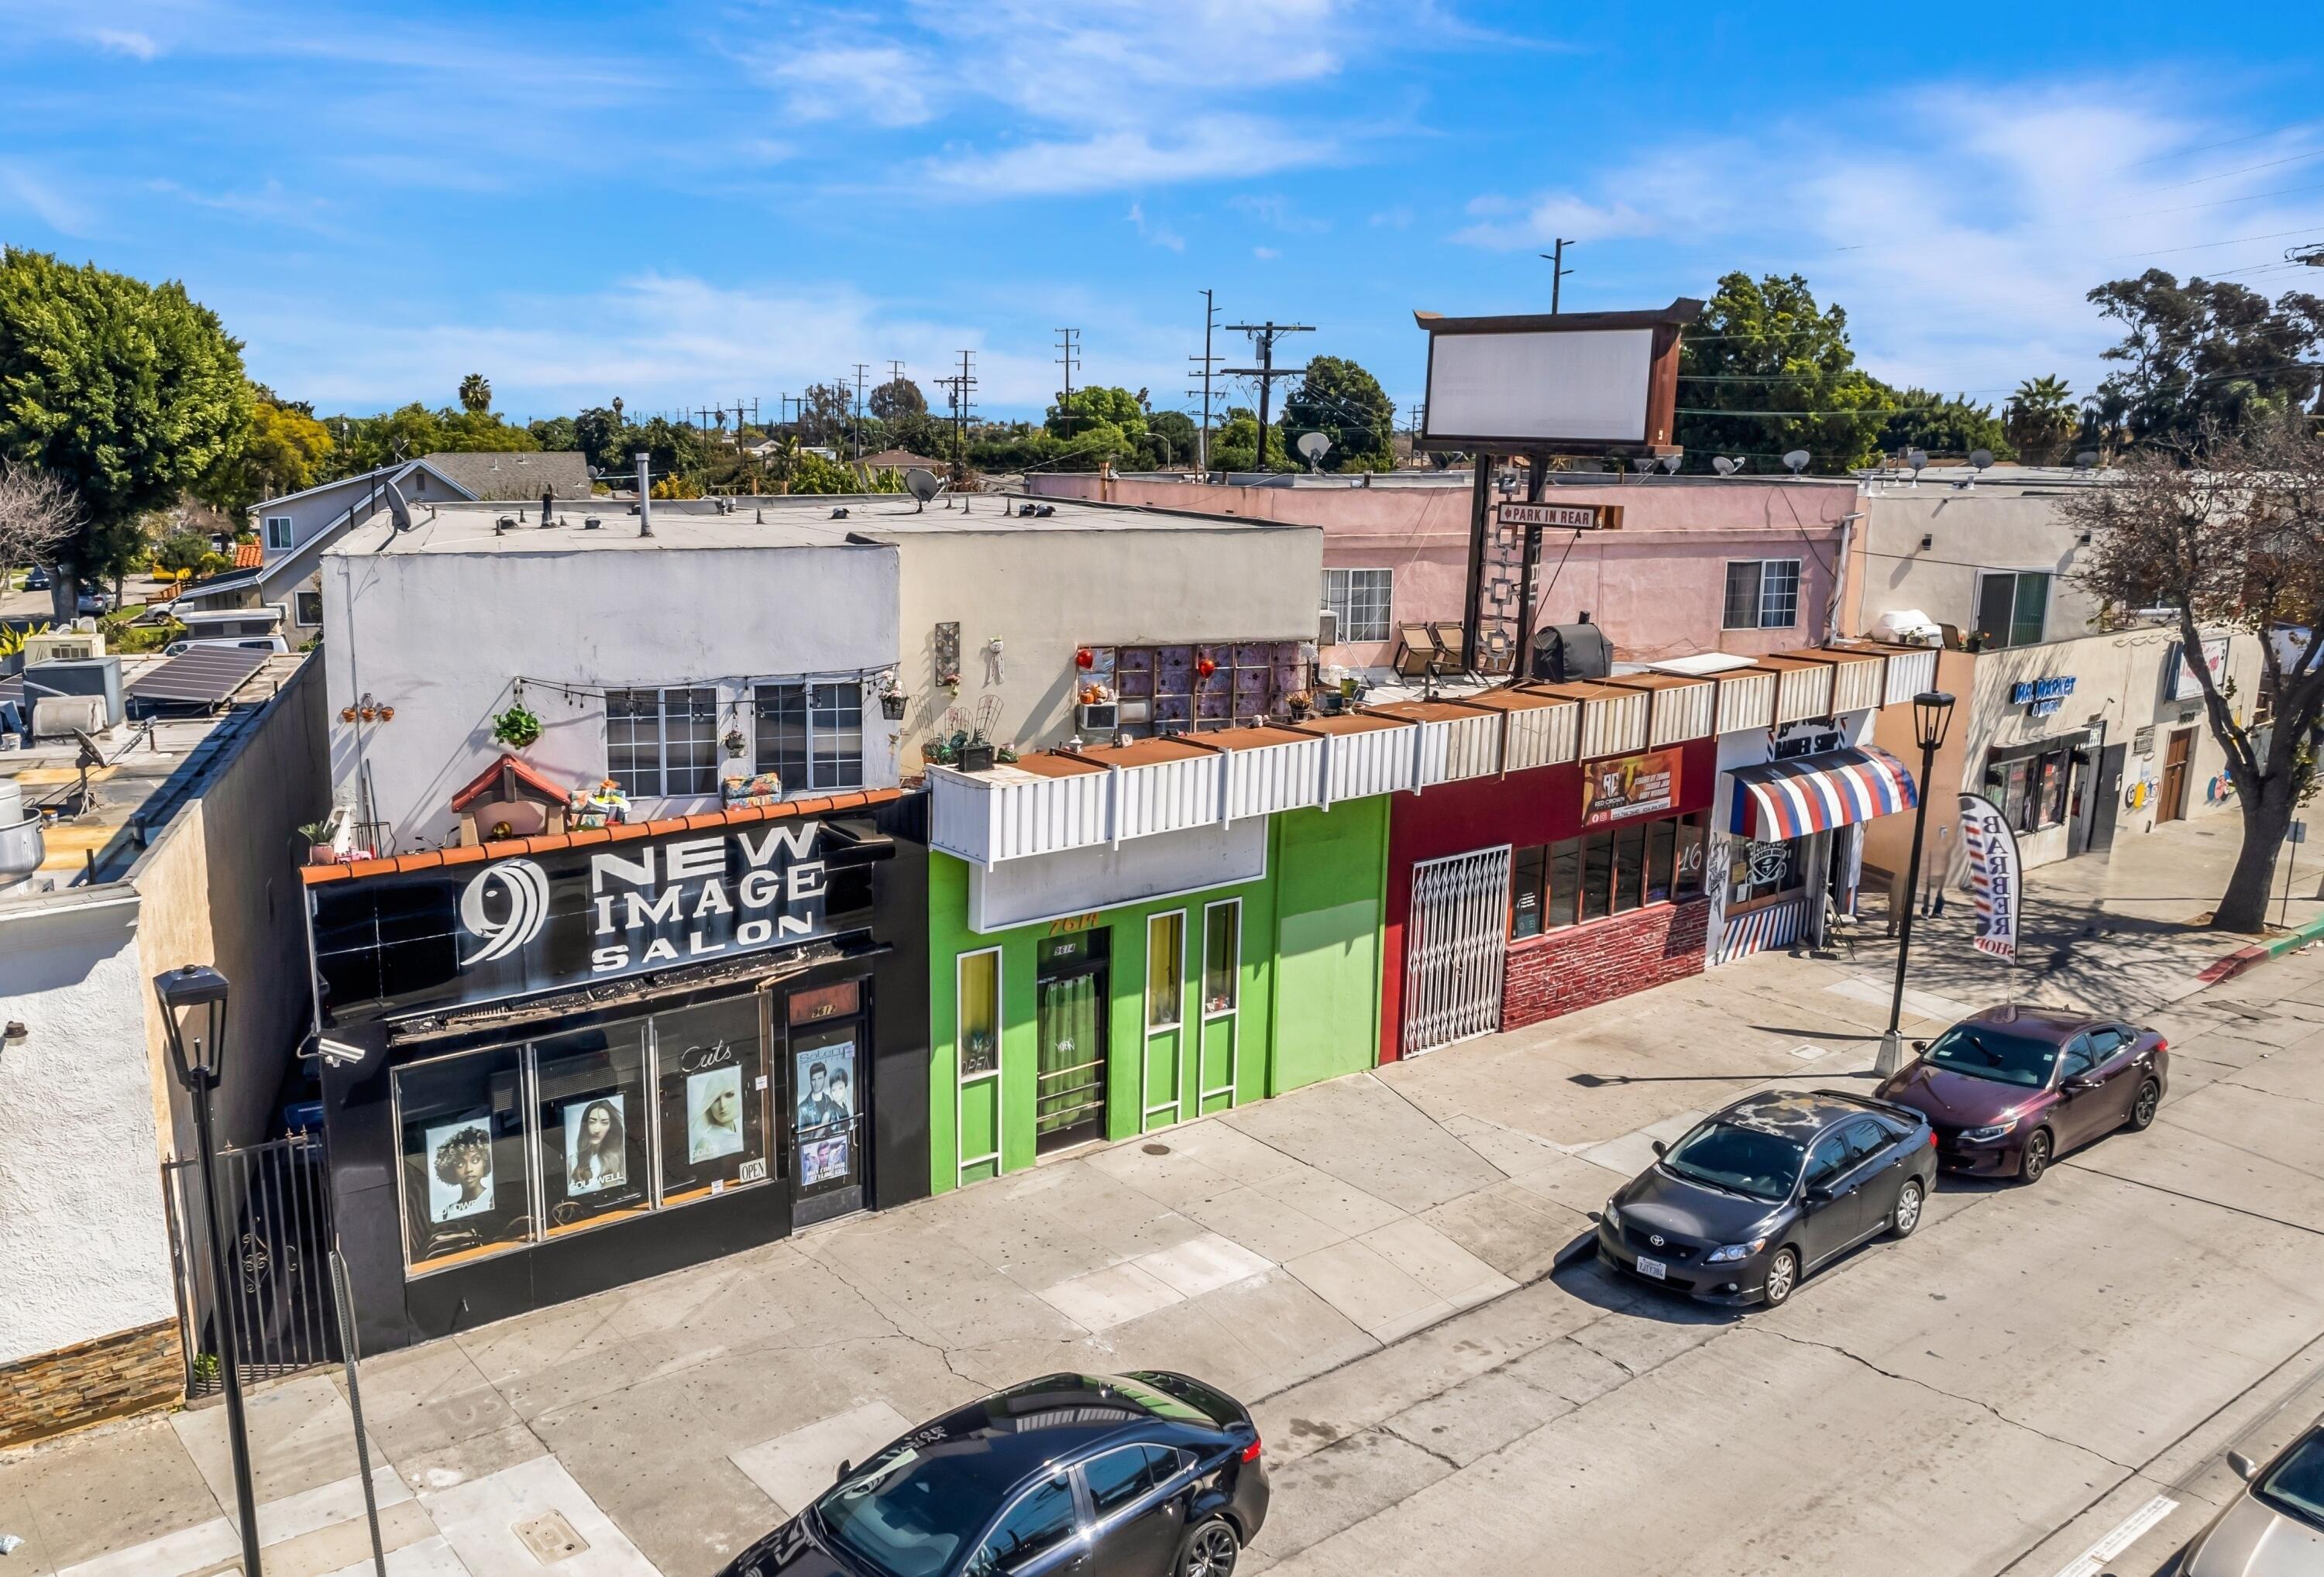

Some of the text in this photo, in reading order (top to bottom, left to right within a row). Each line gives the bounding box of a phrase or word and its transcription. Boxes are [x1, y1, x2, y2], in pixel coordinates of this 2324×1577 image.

[1513, 507, 1590, 525] PARK IN REAR
[1594, 798, 1605, 808] RED
[1605, 795, 1625, 806] CROWN
[591, 822, 820, 894] NEW
[594, 860, 827, 936] IMAGE
[592, 912, 813, 973] SALON
[1054, 943, 1076, 956] 9614
[812, 1005, 837, 1018] 9612
[681, 1039, 731, 1073] Cuts
[741, 1161, 765, 1180] OPEN
